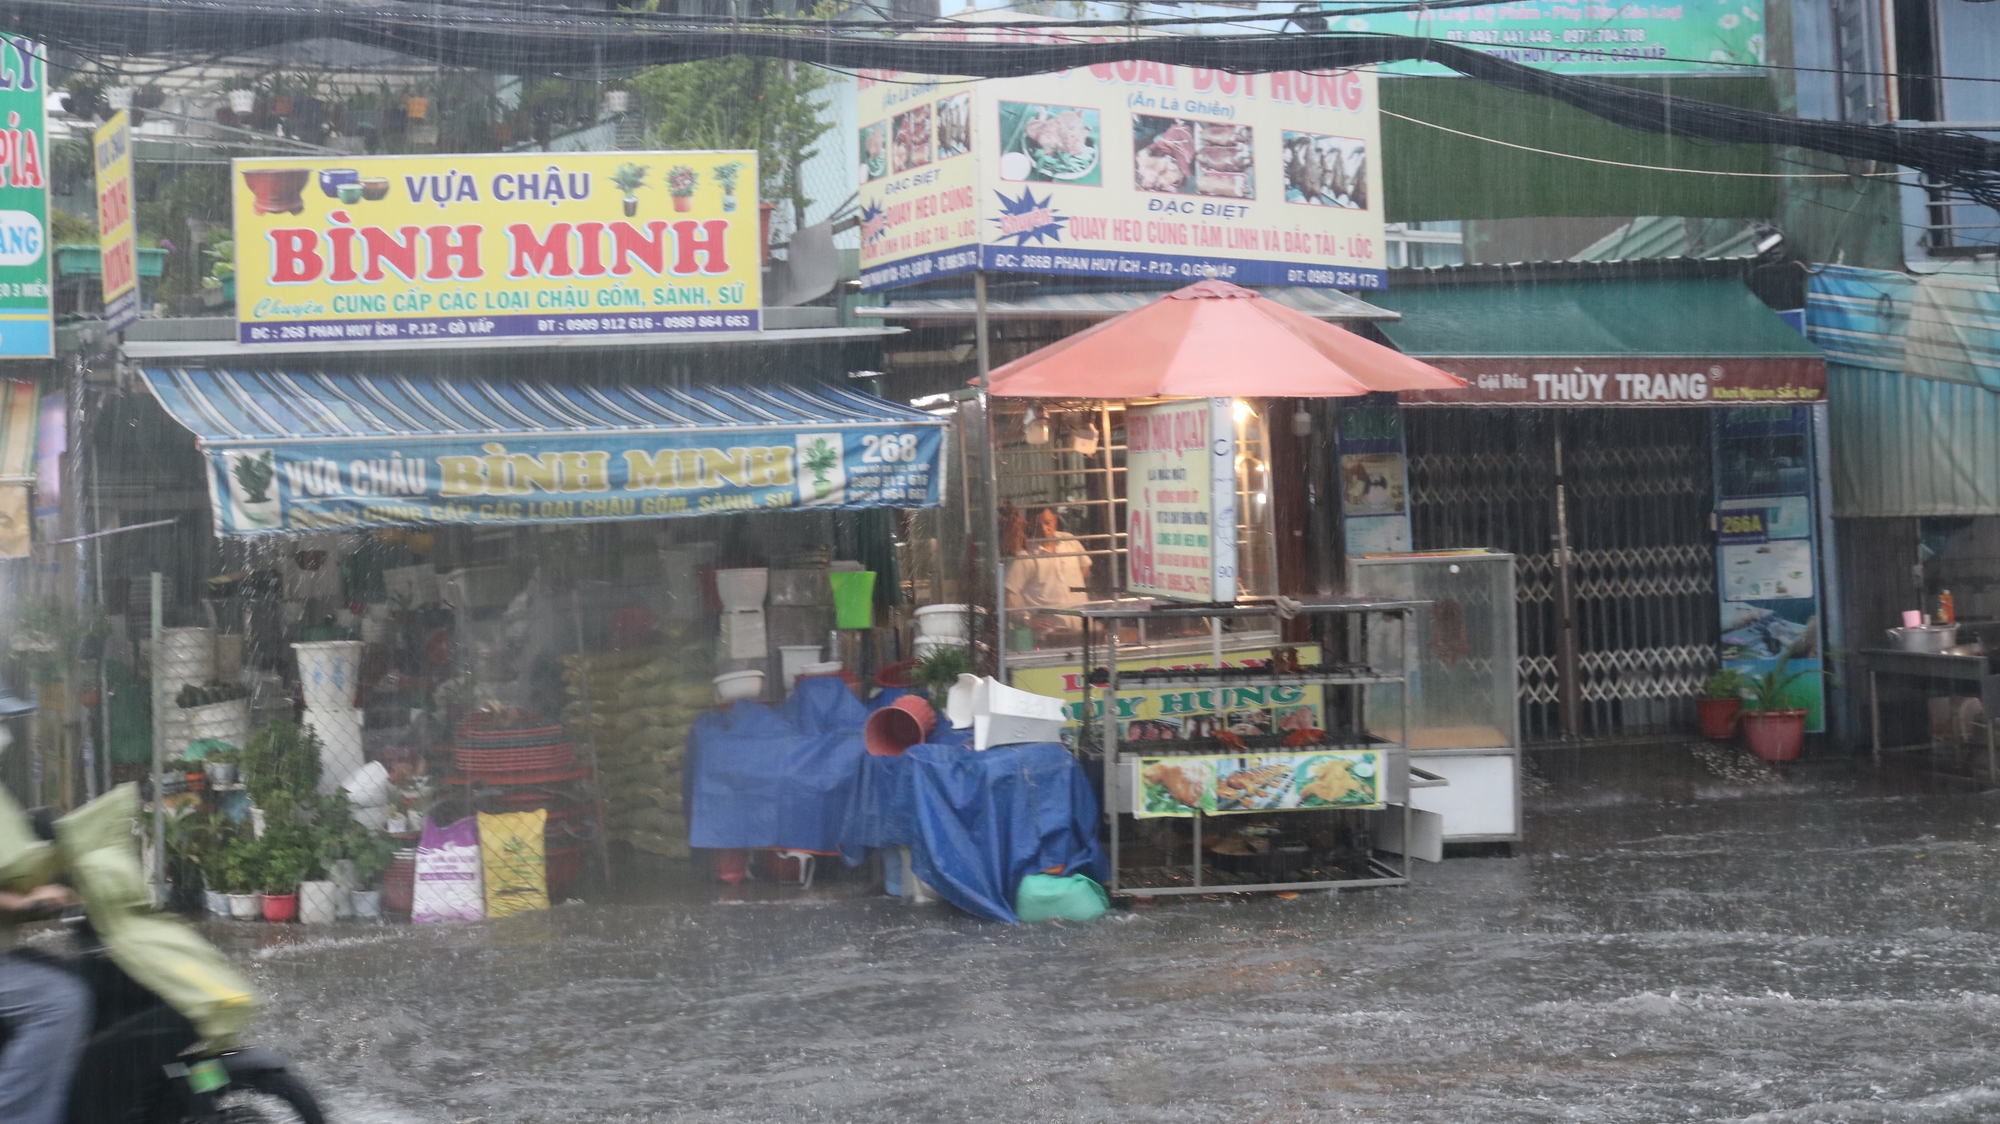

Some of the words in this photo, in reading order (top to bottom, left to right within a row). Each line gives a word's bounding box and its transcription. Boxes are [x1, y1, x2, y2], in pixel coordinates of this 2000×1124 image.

[405, 169, 480, 208] VỰA
[492, 166, 590, 206] CHẬU
[1202, 202, 1249, 220] BIỆT
[266, 210, 485, 286] BÌNH
[504, 220, 731, 281] MINH
[1069, 215, 1107, 241] QUAY
[1113, 218, 1141, 242] HEO
[1227, 227, 1258, 250] LINH
[1263, 226, 1280, 252] VÀ
[1315, 229, 1336, 256] TÀI
[1054, 256, 1088, 271] PHAN
[1091, 258, 1118, 272] HUY
[1336, 271, 1357, 286] 254
[1358, 273, 1379, 288] 175
[333, 294, 387, 314] CUNG
[393, 286, 432, 312] CẤP
[439, 286, 478, 311] CÁC
[485, 291, 530, 312] LOẠI
[536, 284, 590, 312] CHẬU
[597, 281, 646, 309] GỐM,
[653, 282, 712, 308] SÀNH,
[718, 280, 745, 304] SỨ
[309, 324, 344, 338] PHAN
[347, 324, 373, 337] HUY
[408, 322, 437, 336] P.12
[566, 319, 598, 331] 0909
[601, 318, 626, 330] 912
[629, 317, 653, 330] 616
[727, 315, 750, 327] 663
[1532, 367, 1609, 399] THÙY
[1614, 373, 1708, 399] TRANG
[861, 433, 918, 463] 268
[436, 442, 611, 497] BÌNH
[623, 446, 796, 490] MINH
